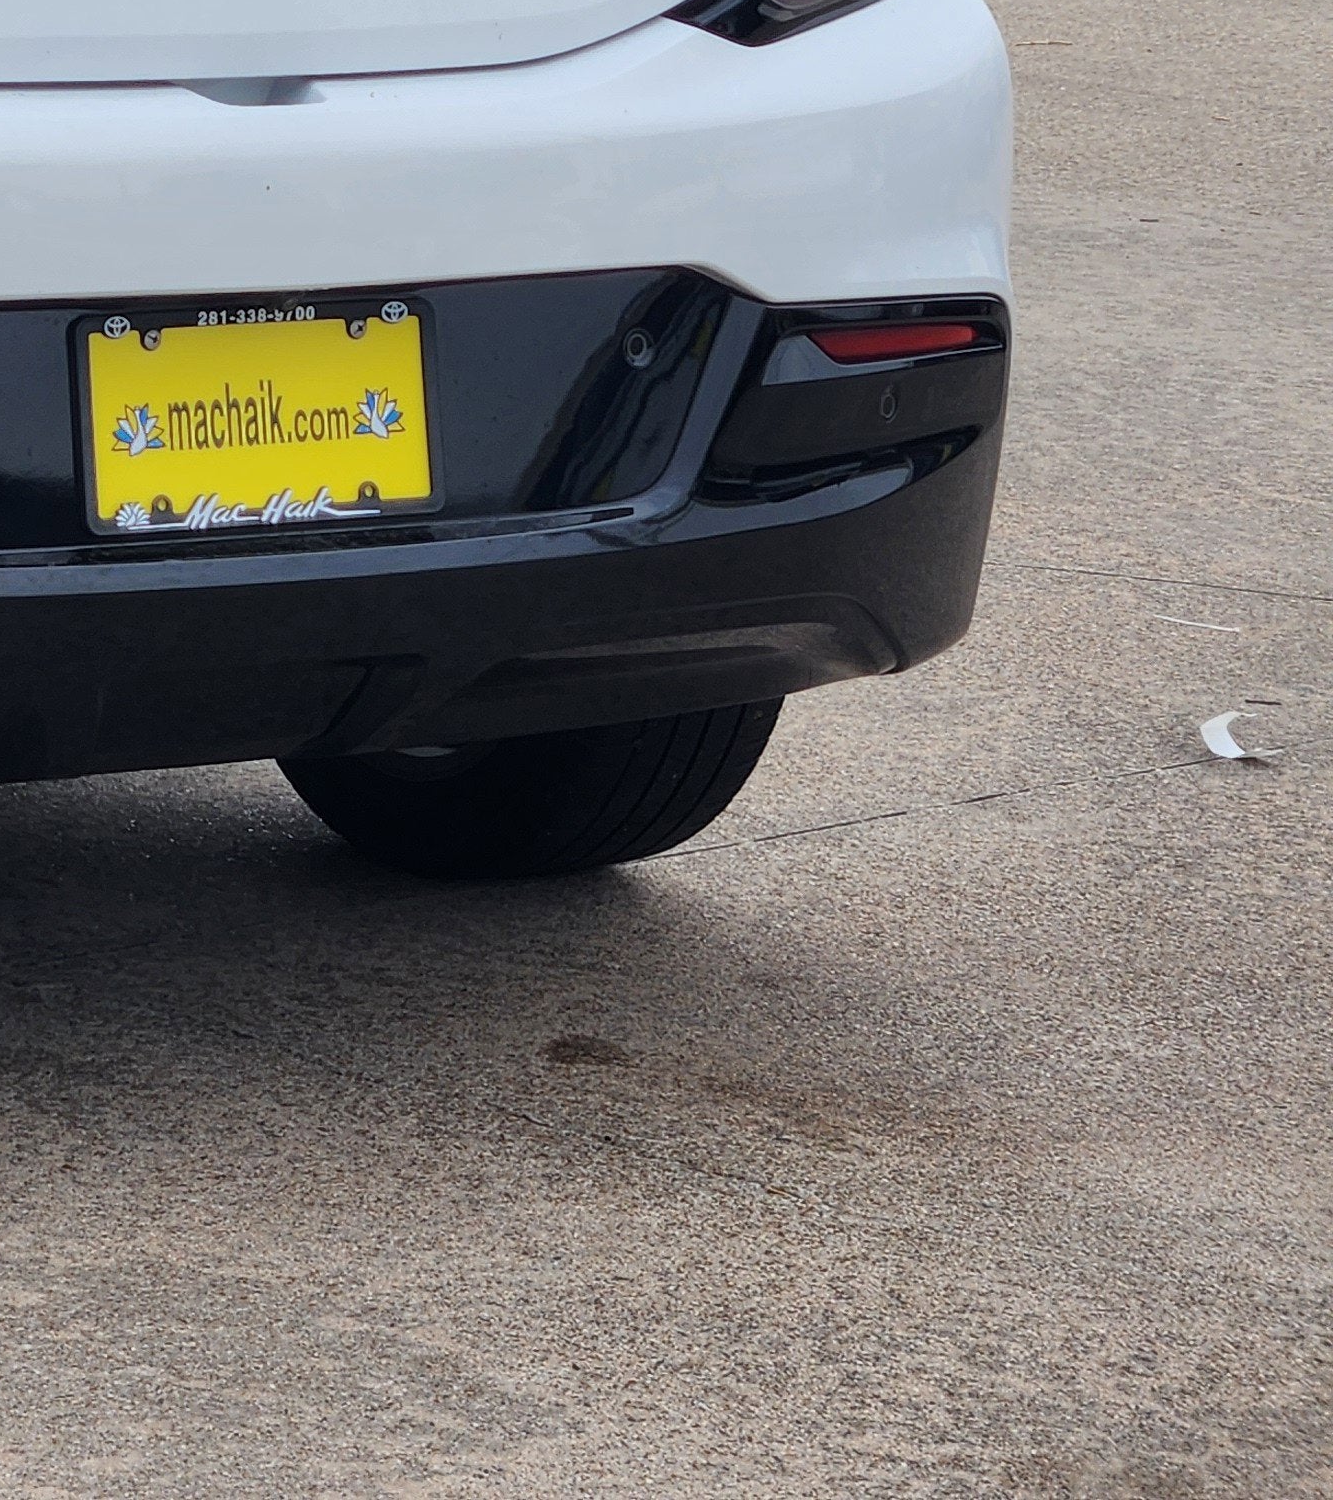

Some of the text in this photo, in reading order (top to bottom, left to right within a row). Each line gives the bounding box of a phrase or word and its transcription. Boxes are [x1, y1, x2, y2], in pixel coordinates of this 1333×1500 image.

[167, 379, 351, 451] machaik.com
[184, 486, 355, 531] Mac Haik
